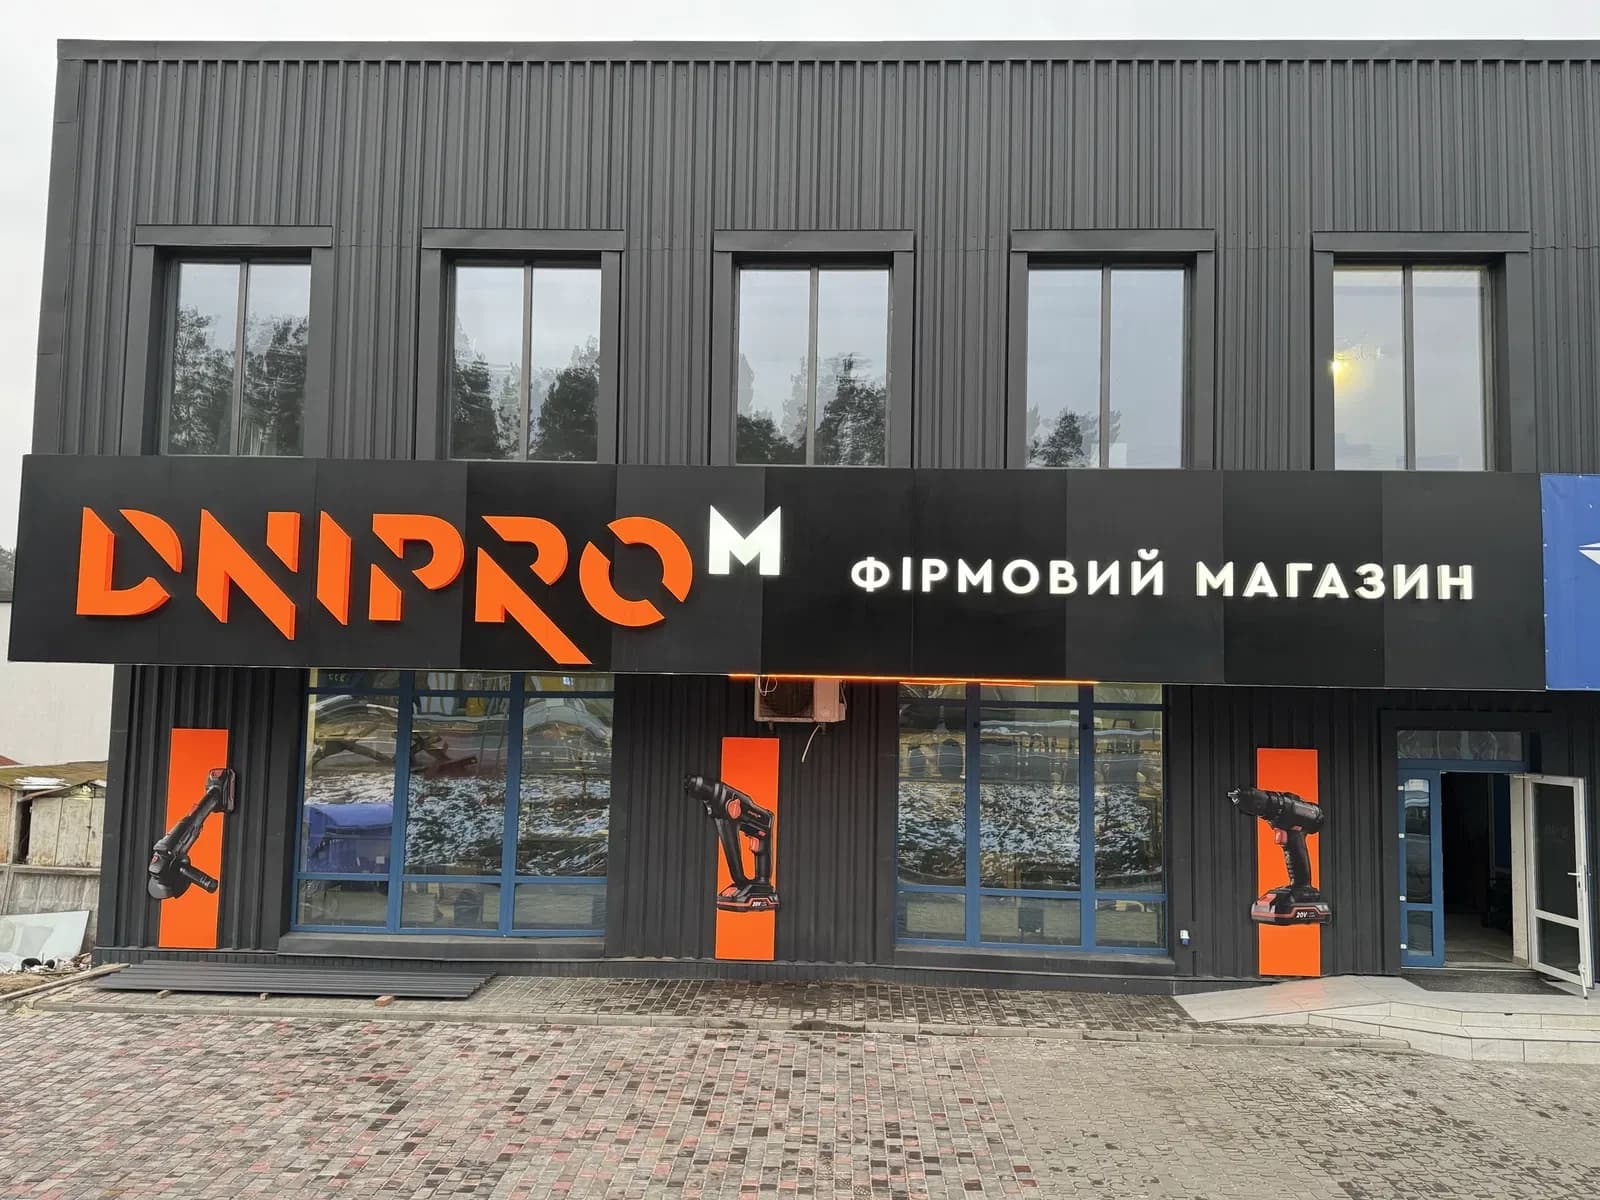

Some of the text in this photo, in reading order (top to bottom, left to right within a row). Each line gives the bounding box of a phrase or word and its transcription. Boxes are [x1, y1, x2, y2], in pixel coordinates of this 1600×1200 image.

[76, 504, 783, 665] DNIPRO M
[850, 548, 1475, 600] ФІРМОВИЙ МАГАЗИН
